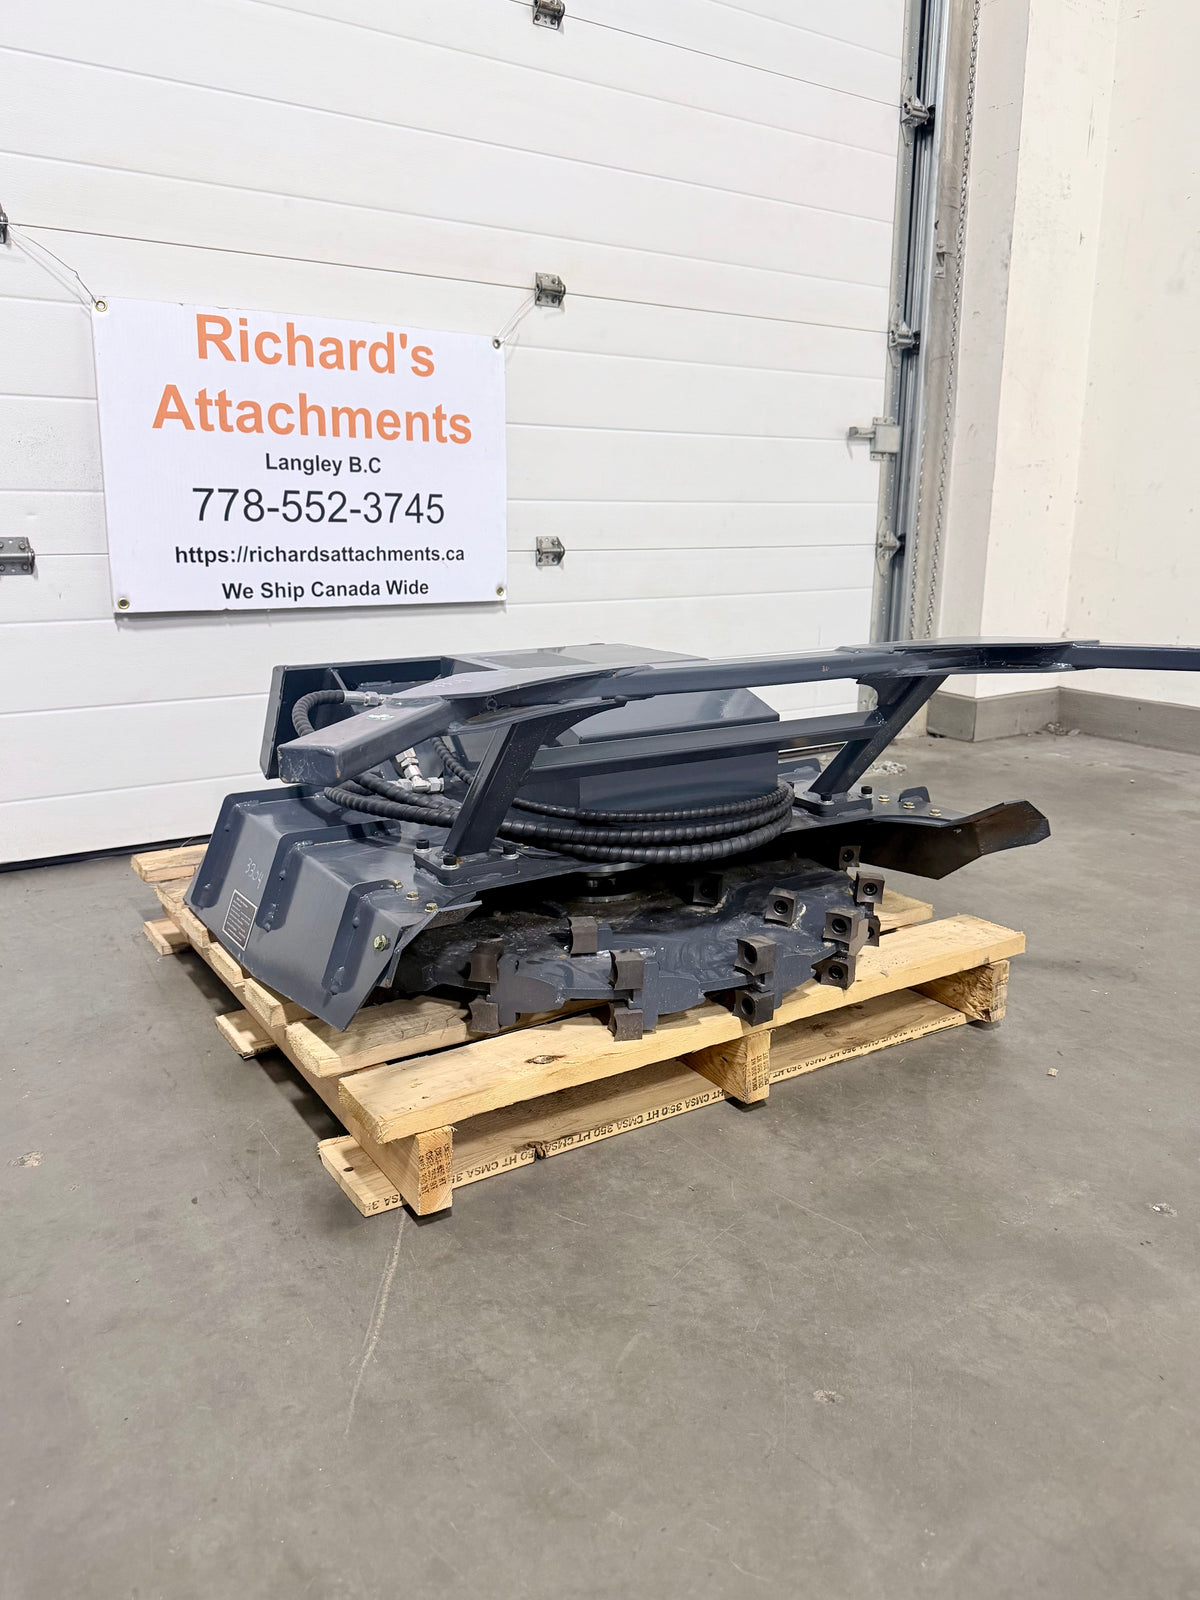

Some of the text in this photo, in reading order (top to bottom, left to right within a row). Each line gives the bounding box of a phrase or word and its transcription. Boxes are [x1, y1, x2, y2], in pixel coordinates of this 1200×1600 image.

[196, 313, 435, 378] Richard's
[151, 383, 472, 445] Attachments
[264, 452, 382, 477] Langley B.C
[192, 487, 445, 524] 778-552-3745
[175, 545, 466, 568] https://richardsattachments.ca
[221, 579, 430, 602] We Ship Canada Wide
[645, 1109, 660, 1122] HT
[466, 1160, 500, 1179] CMSA
[501, 1154, 518, 1168] HT
